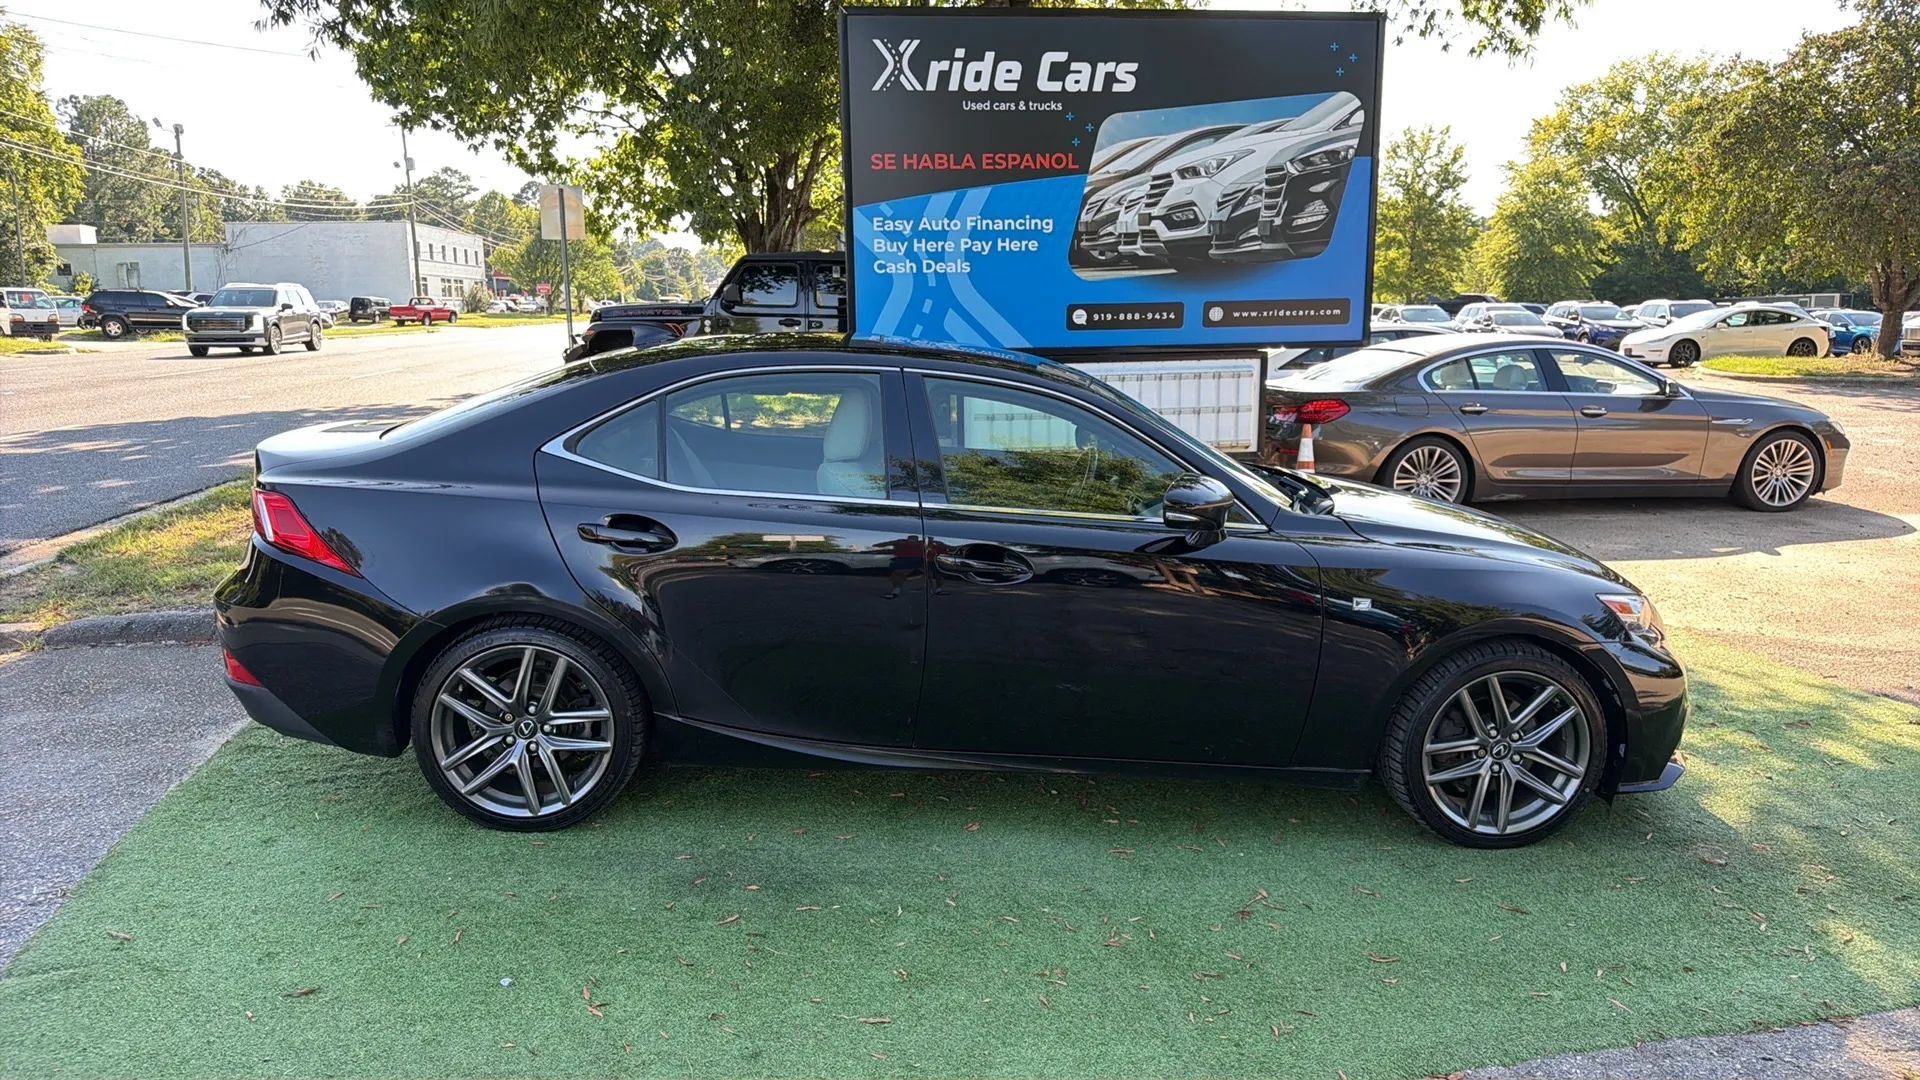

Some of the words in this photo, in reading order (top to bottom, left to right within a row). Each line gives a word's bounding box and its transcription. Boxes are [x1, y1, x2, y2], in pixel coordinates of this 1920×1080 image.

[1036, 51, 1139, 92] Cars
[962, 100, 991, 111] Used
[992, 101, 1016, 111] cars
[1018, 100, 1027, 111] &
[1028, 100, 1063, 111] trucks
[870, 153, 897, 170] SE
[903, 153, 976, 170] HABLA
[982, 152, 1079, 170] ESPANOL
[872, 217, 914, 234] Easy
[918, 217, 961, 231] Auto
[966, 215, 1053, 233] Financing
[873, 238, 908, 256] Buy
[913, 238, 955, 252] Here
[960, 238, 993, 255] Pay
[997, 237, 1039, 251] Here
[873, 259, 917, 274] Cash
[922, 258, 971, 273] Deals
[1092, 311, 1176, 321] 919-888-9434
[1232, 308, 1342, 318] www.xridecars.com
